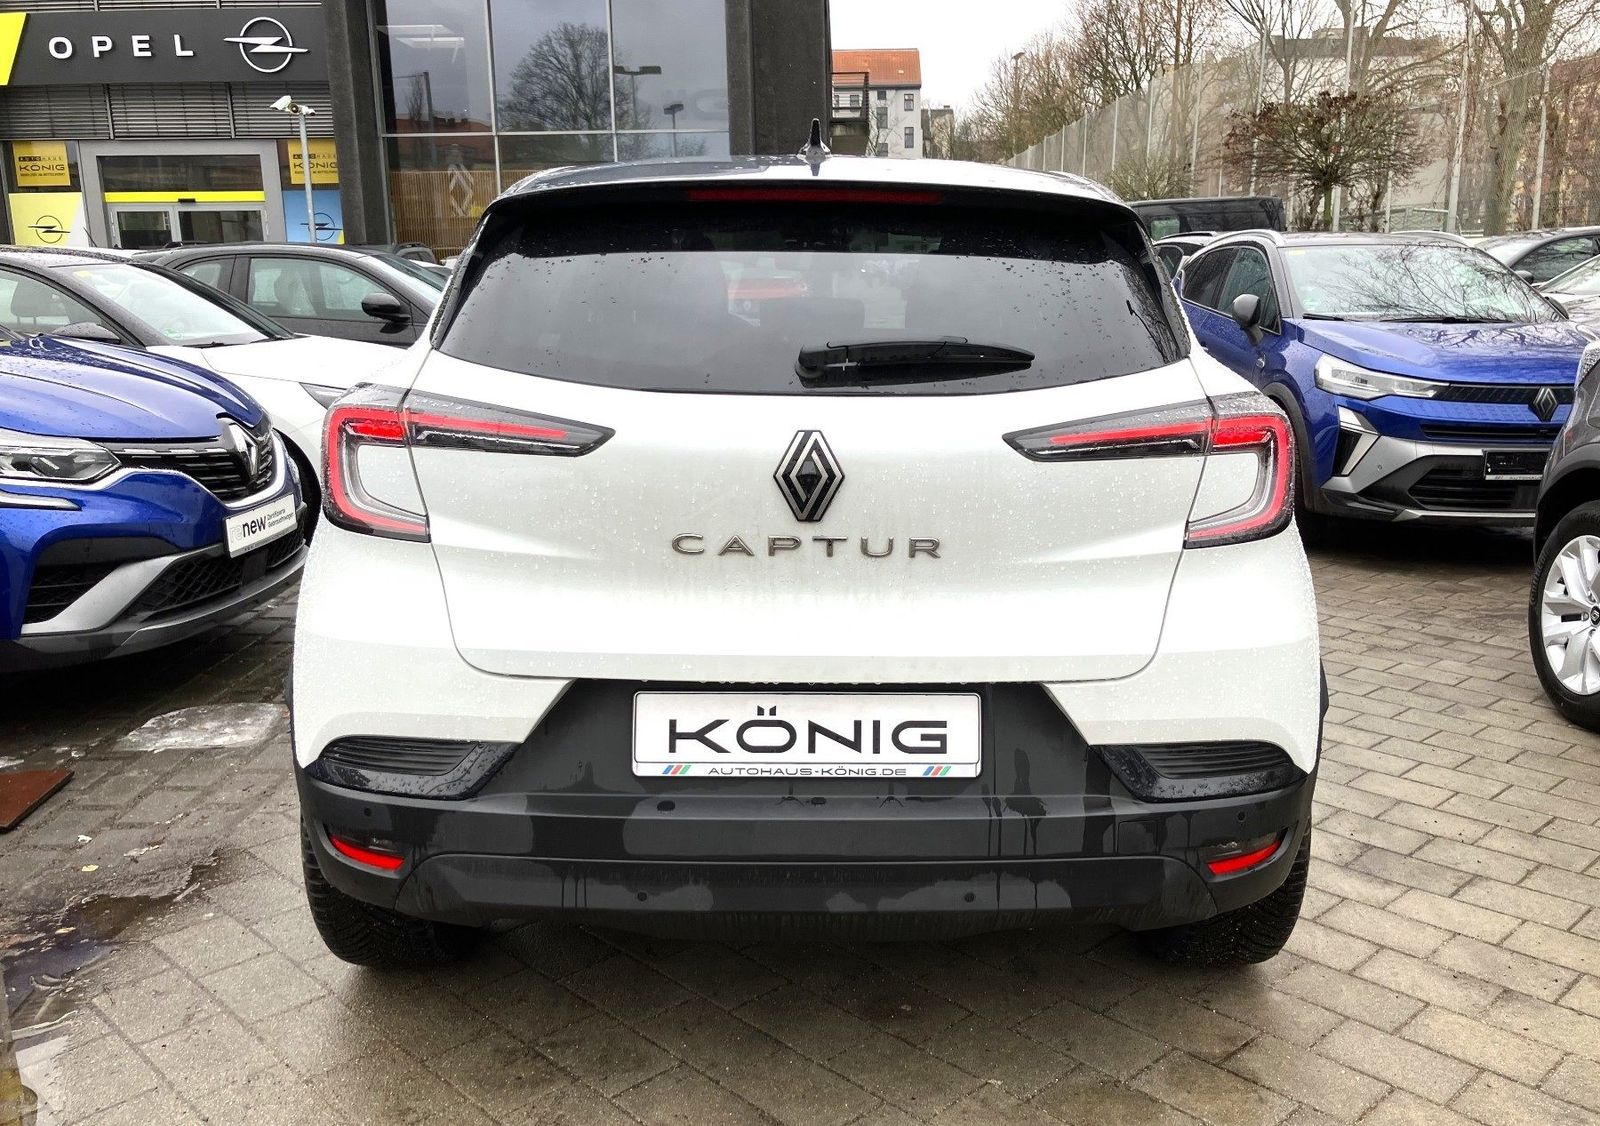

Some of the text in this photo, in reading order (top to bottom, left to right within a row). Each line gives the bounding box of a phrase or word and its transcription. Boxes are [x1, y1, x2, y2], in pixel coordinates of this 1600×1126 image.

[49, 34, 194, 59] OPEL
[672, 533, 942, 559] CAPTUR
[668, 705, 948, 755] KÖNIG
[708, 765, 907, 776] AUTOHAUS-KÖNIG.DE
